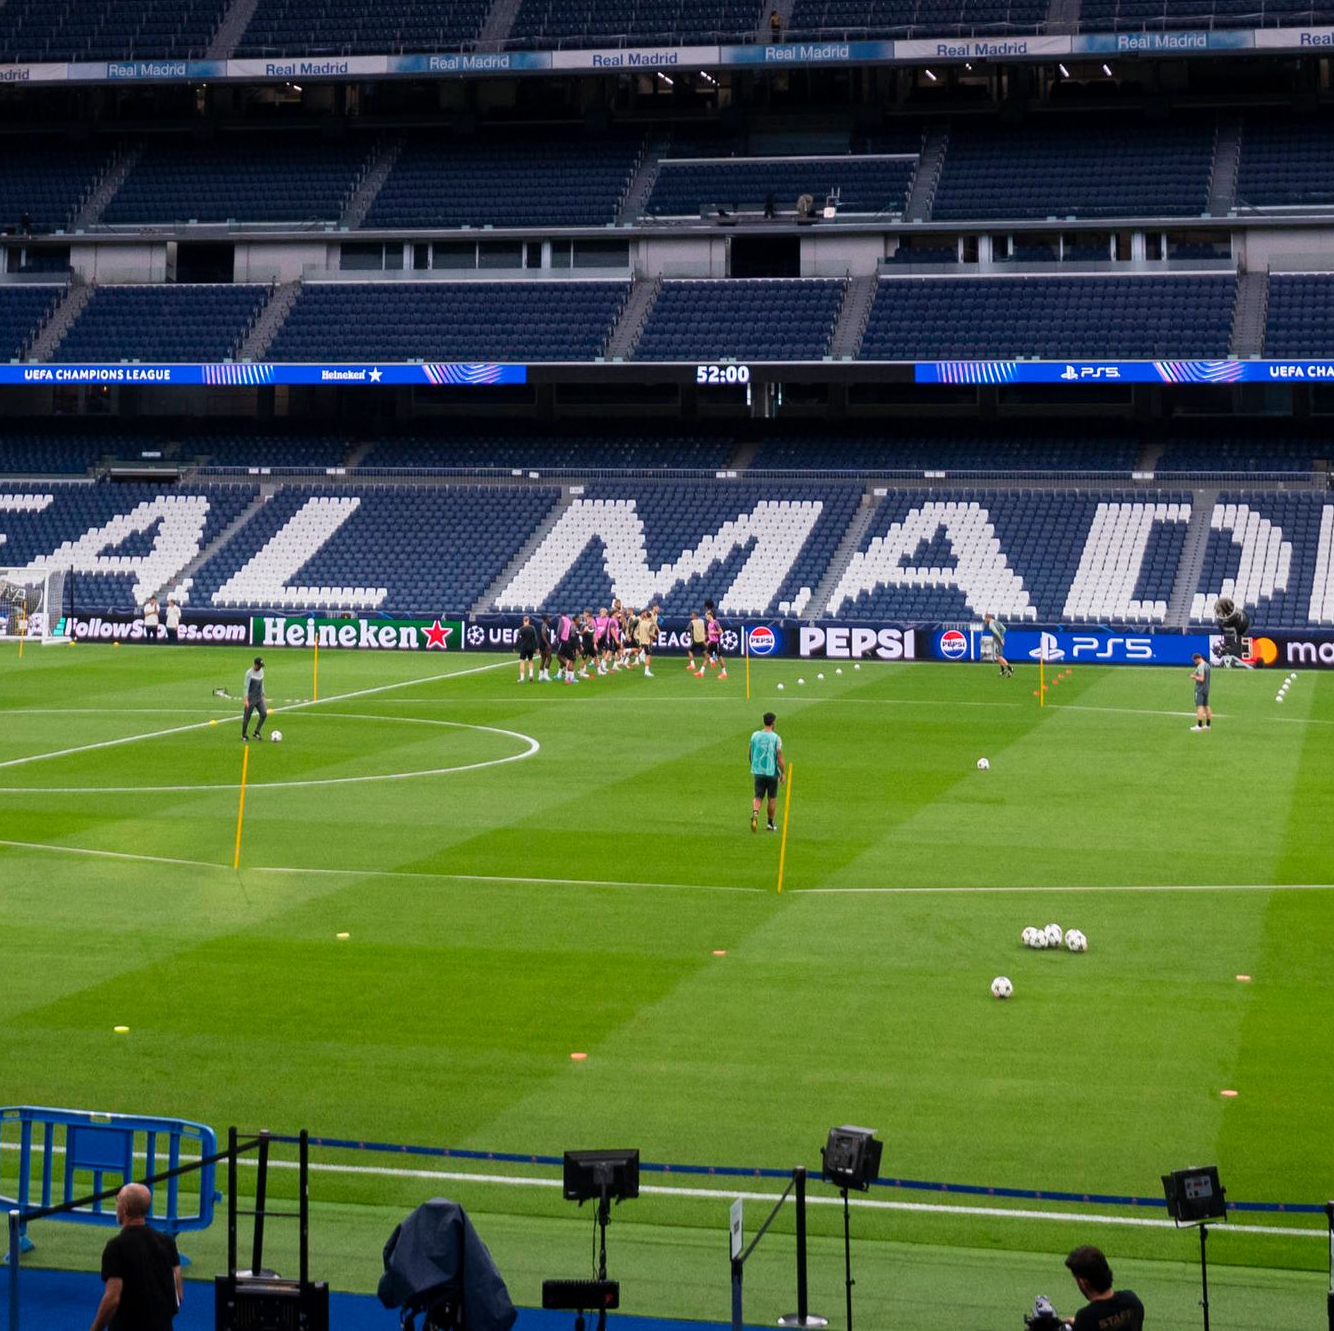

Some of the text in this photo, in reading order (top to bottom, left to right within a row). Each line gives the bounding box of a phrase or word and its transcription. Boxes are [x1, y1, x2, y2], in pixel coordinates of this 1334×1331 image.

[1118, 34, 1207, 48] Real Madrid
[1300, 32, 1334, 45] Real
[765, 46, 849, 59] Real Madrid
[936, 42, 1027, 56] Real Madrid
[429, 56, 509, 69] Real Madrid
[593, 52, 677, 66] Real Madrid
[109, 64, 186, 76] Real Madrid
[266, 62, 347, 75] Real Madrid
[24, 369, 170, 380] UEFA CHAMPIONS LEAGUE
[321, 370, 366, 380] Heineken
[697, 366, 749, 382] 52:00
[1081, 367, 1120, 377] PS5
[1270, 366, 1303, 377] UEFA
[264, 617, 419, 648] Heineken
[800, 627, 914, 658] PEPSI
[1073, 638, 1154, 657] PS5
